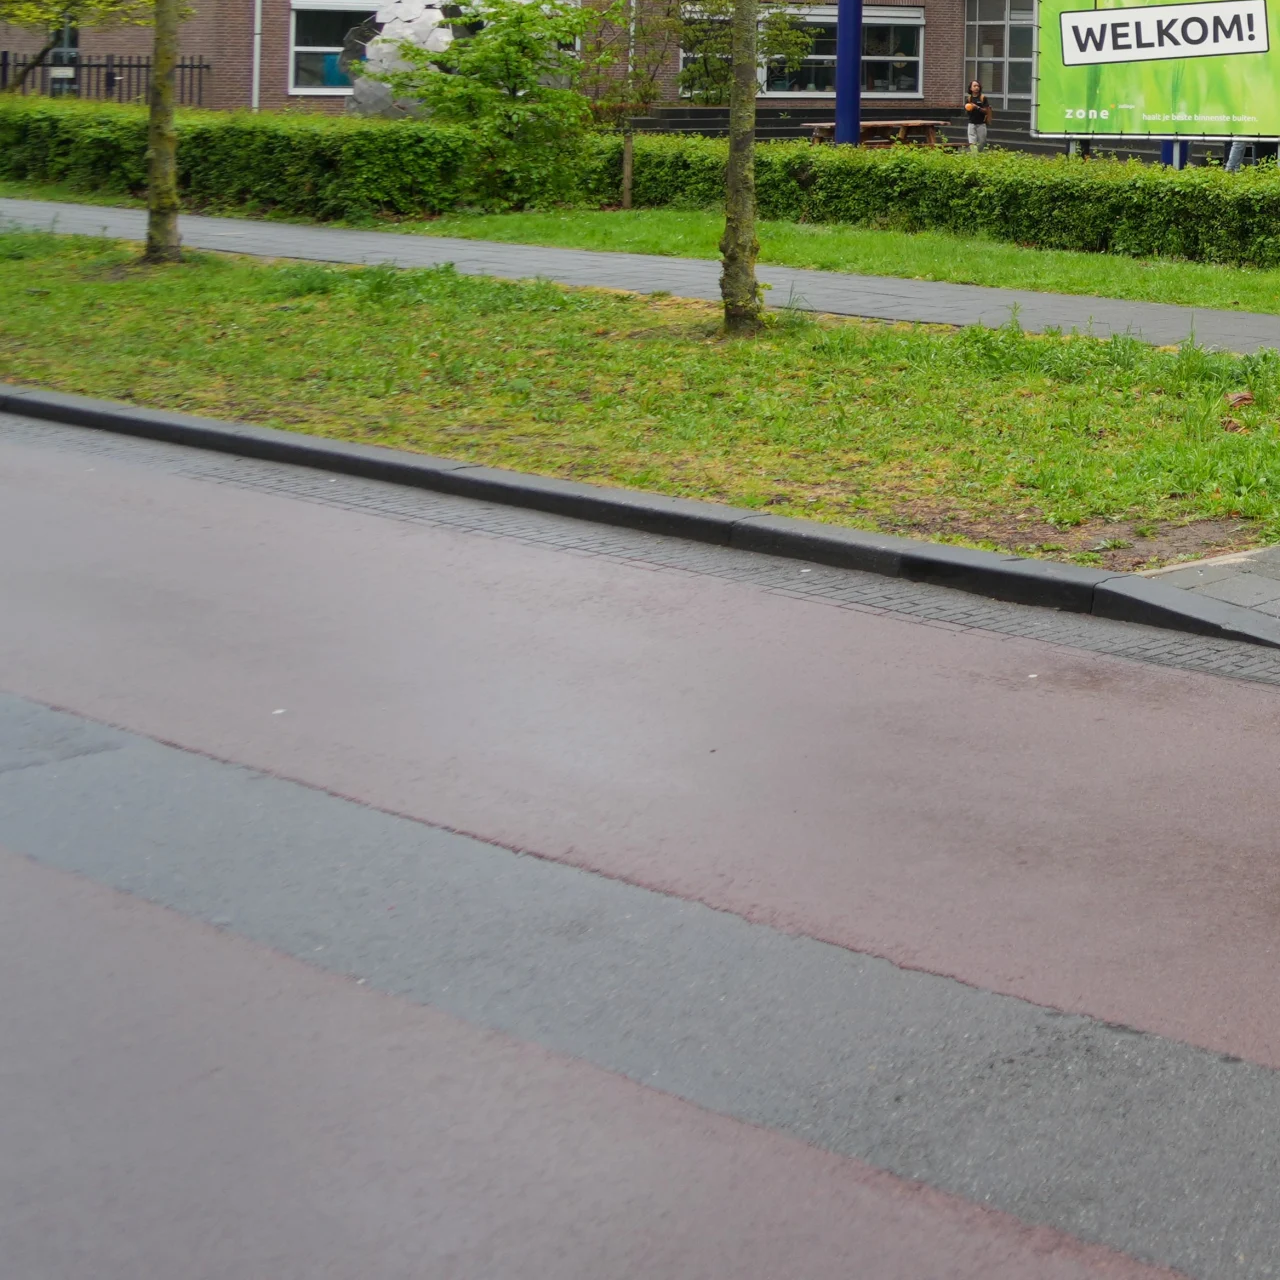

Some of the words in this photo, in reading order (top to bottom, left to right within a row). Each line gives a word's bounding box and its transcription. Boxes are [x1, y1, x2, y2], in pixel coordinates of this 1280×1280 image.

[1071, 13, 1256, 53] WELKOM!
[1065, 108, 1110, 119] zone
[1142, 113, 1161, 121] haalt
[1163, 113, 1171, 122] je
[1171, 113, 1192, 121] beste
